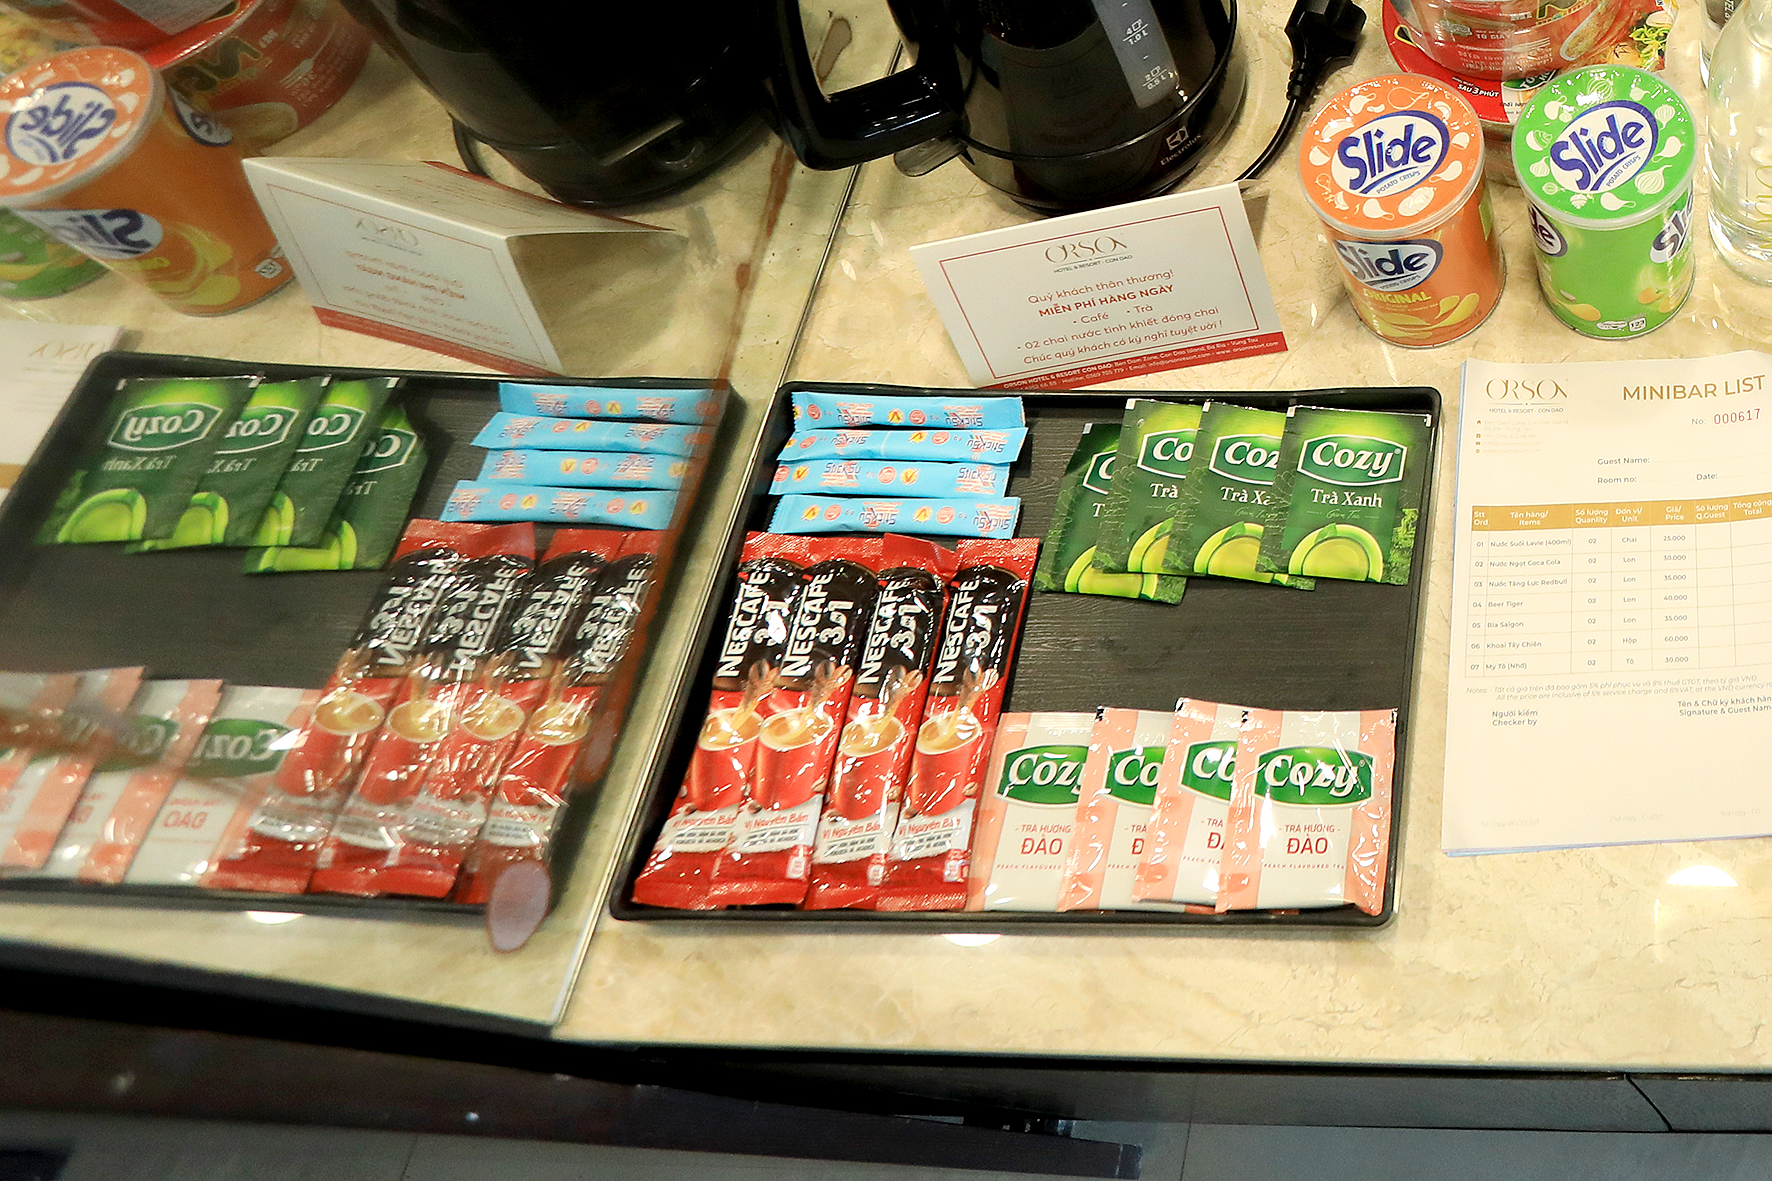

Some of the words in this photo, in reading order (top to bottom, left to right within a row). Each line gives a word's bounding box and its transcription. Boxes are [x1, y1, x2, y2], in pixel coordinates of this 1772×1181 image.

[1473, 87, 1479, 95] 3
[1337, 124, 1437, 191] Slide
[1550, 114, 1645, 191] Slide
[1333, 241, 1430, 281] Slide
[1056, 285, 1093, 300] khách
[1099, 292, 1136, 305] HÀNG
[1139, 284, 1174, 299] NGÀY
[1024, 341, 1041, 350] 02
[1043, 335, 1068, 347] chai
[1194, 307, 1219, 318] chai
[1081, 312, 1109, 324] Café
[1077, 340, 1111, 354] khách
[1623, 383, 1717, 400] MINIBAR
[1725, 374, 1766, 396] LIST
[1714, 408, 1761, 425] 000617
[1152, 438, 1195, 462] Co
[1224, 441, 1280, 468] Coz
[1312, 440, 1396, 477] Cozy
[1696, 473, 1718, 481] Date:
[1149, 483, 1179, 498] Trà
[1221, 485, 1249, 503] Trà
[1310, 488, 1339, 506] Trà
[1341, 491, 1383, 508] Xanh
[1679, 709, 1718, 717] Signature
[1115, 754, 1162, 787] Co
[1264, 754, 1359, 796] Cozy
[1020, 834, 1062, 855] ĐÀO
[1286, 834, 1328, 855] ĐÀO
